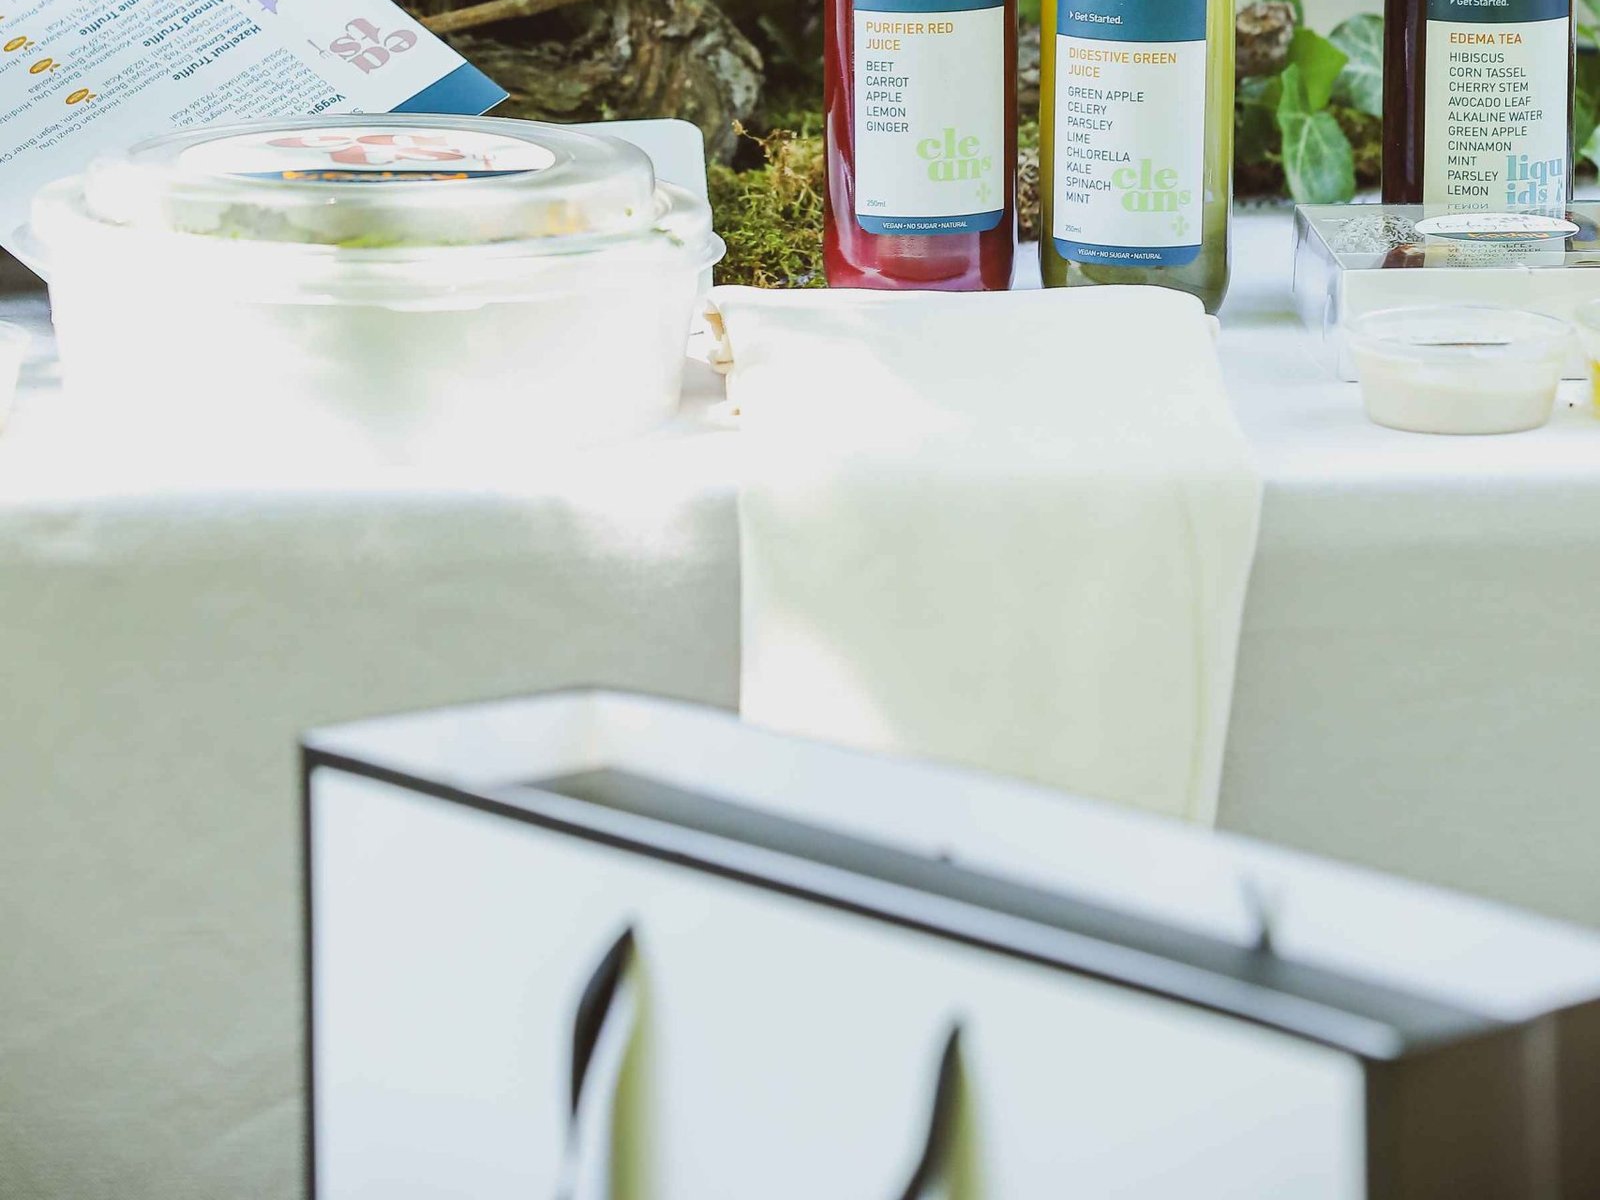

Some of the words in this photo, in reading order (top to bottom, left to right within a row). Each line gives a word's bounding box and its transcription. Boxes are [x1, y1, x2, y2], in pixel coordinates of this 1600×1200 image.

[78, 11, 119, 35] Truffle
[1074, 11, 1089, 21] Get
[1090, 13, 1123, 25] Started.
[142, 22, 183, 46] Truffle
[866, 22, 924, 34] PURIFIER
[928, 23, 953, 34] RED
[210, 24, 261, 57] Hazelnut
[866, 39, 901, 50] JUICE
[1450, 33, 1495, 44] EDEMA
[1499, 34, 1522, 44] TEA
[1069, 48, 1130, 63] DIGESTIVE
[1133, 53, 1177, 64] GREEN
[1450, 52, 1505, 63] HIBISCUS
[172, 55, 213, 80] Truffle
[866, 61, 894, 72] BEET
[1068, 64, 1100, 78] JUICE
[1450, 67, 1482, 77] CORN
[1486, 67, 1526, 78] TASSEL
[866, 76, 909, 88] CARROT
[1449, 82, 1496, 92] CHERRY
[1499, 82, 1529, 92] STEM
[866, 92, 902, 102] APPLE
[1067, 86, 1102, 100] GREEN
[1106, 91, 1144, 103] APPLE
[1448, 96, 1500, 107] AVOCADO
[1504, 96, 1531, 107] LEAF
[866, 106, 906, 117] LEMON
[1068, 102, 1107, 115] CELERY
[1448, 111, 1506, 122] ALKALINE
[1509, 110, 1543, 121] WATER
[866, 121, 909, 133] GINGER
[1067, 116, 1113, 130] PARSLEY
[1067, 131, 1090, 144] LIME
[1448, 126, 1488, 137] GREEN
[1491, 126, 1527, 136] APPLE
[916, 128, 980, 160] cle
[1448, 141, 1512, 151] CINNAMON
[1067, 146, 1131, 162] CHLORELLA
[1448, 156, 1477, 166] MINT
[1067, 162, 1092, 175] KALE
[1112, 159, 1178, 190] cle
[1506, 155, 1563, 186] liqu
[1448, 170, 1498, 181] PARSLEY
[1066, 176, 1111, 191] SPINACH
[1448, 185, 1489, 196] LEMON
[1066, 191, 1091, 204] MINT
